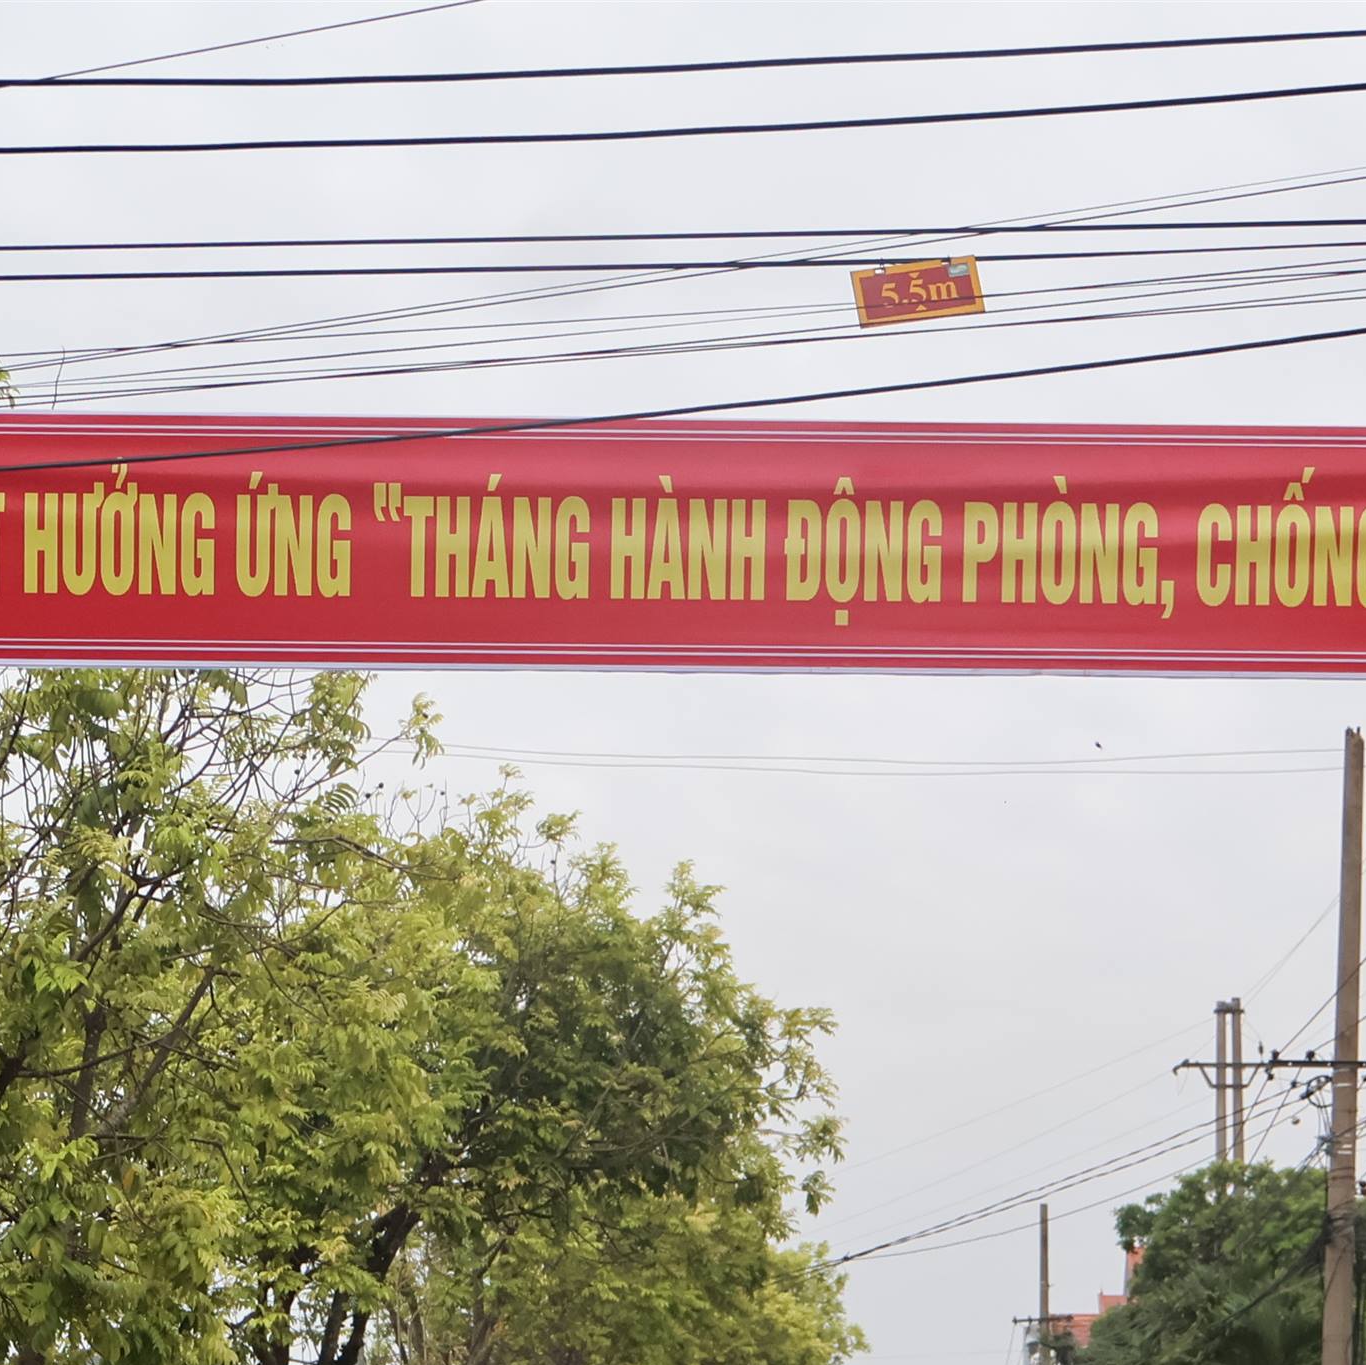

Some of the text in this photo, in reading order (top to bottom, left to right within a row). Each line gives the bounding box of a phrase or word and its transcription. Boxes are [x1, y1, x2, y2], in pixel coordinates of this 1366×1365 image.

[881, 278, 960, 309] 5.5m
[24, 461, 215, 596] HƯỞNG
[237, 473, 351, 598] ỨNG
[611, 475, 766, 600] HÀNH
[785, 477, 942, 626] ĐỘNG
[964, 476, 1174, 618] PHÒNG,
